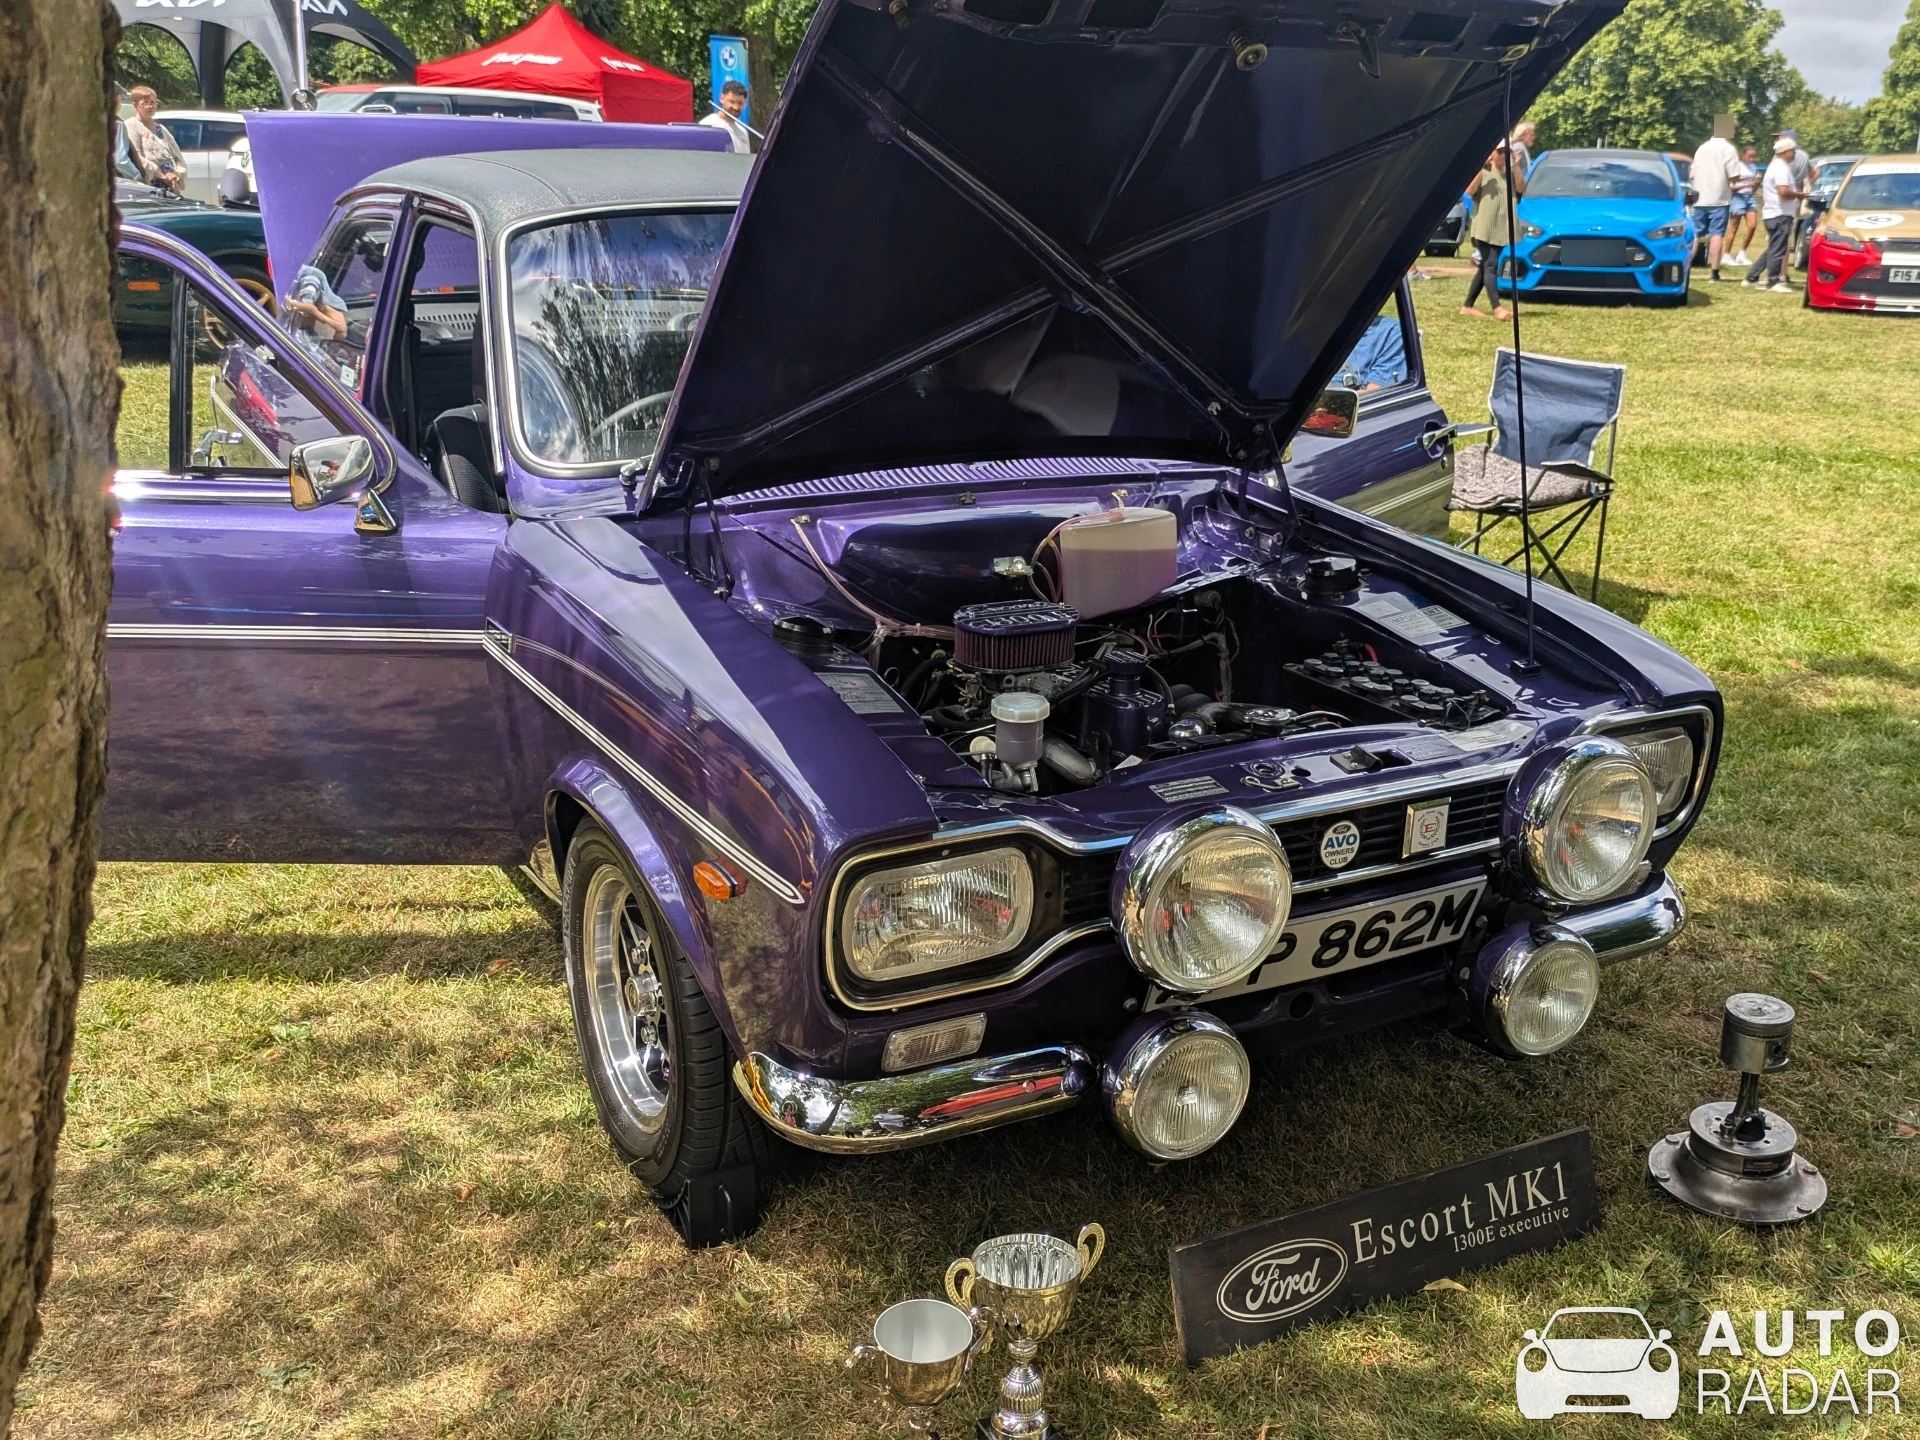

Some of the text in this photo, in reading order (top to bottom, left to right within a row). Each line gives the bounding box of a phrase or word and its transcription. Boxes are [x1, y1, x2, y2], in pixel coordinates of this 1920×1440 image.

[1323, 833, 1358, 850] AVO
[1423, 822, 1437, 834] E
[1325, 847, 1355, 858] OWNERS
[1330, 857, 1348, 866] CLUB
[1311, 887, 1478, 969] 862M
[1350, 1161, 1568, 1264] Escort MK1
[1453, 1206, 1570, 1253] 1300E executive
[1246, 1252, 1321, 1311] Ford
